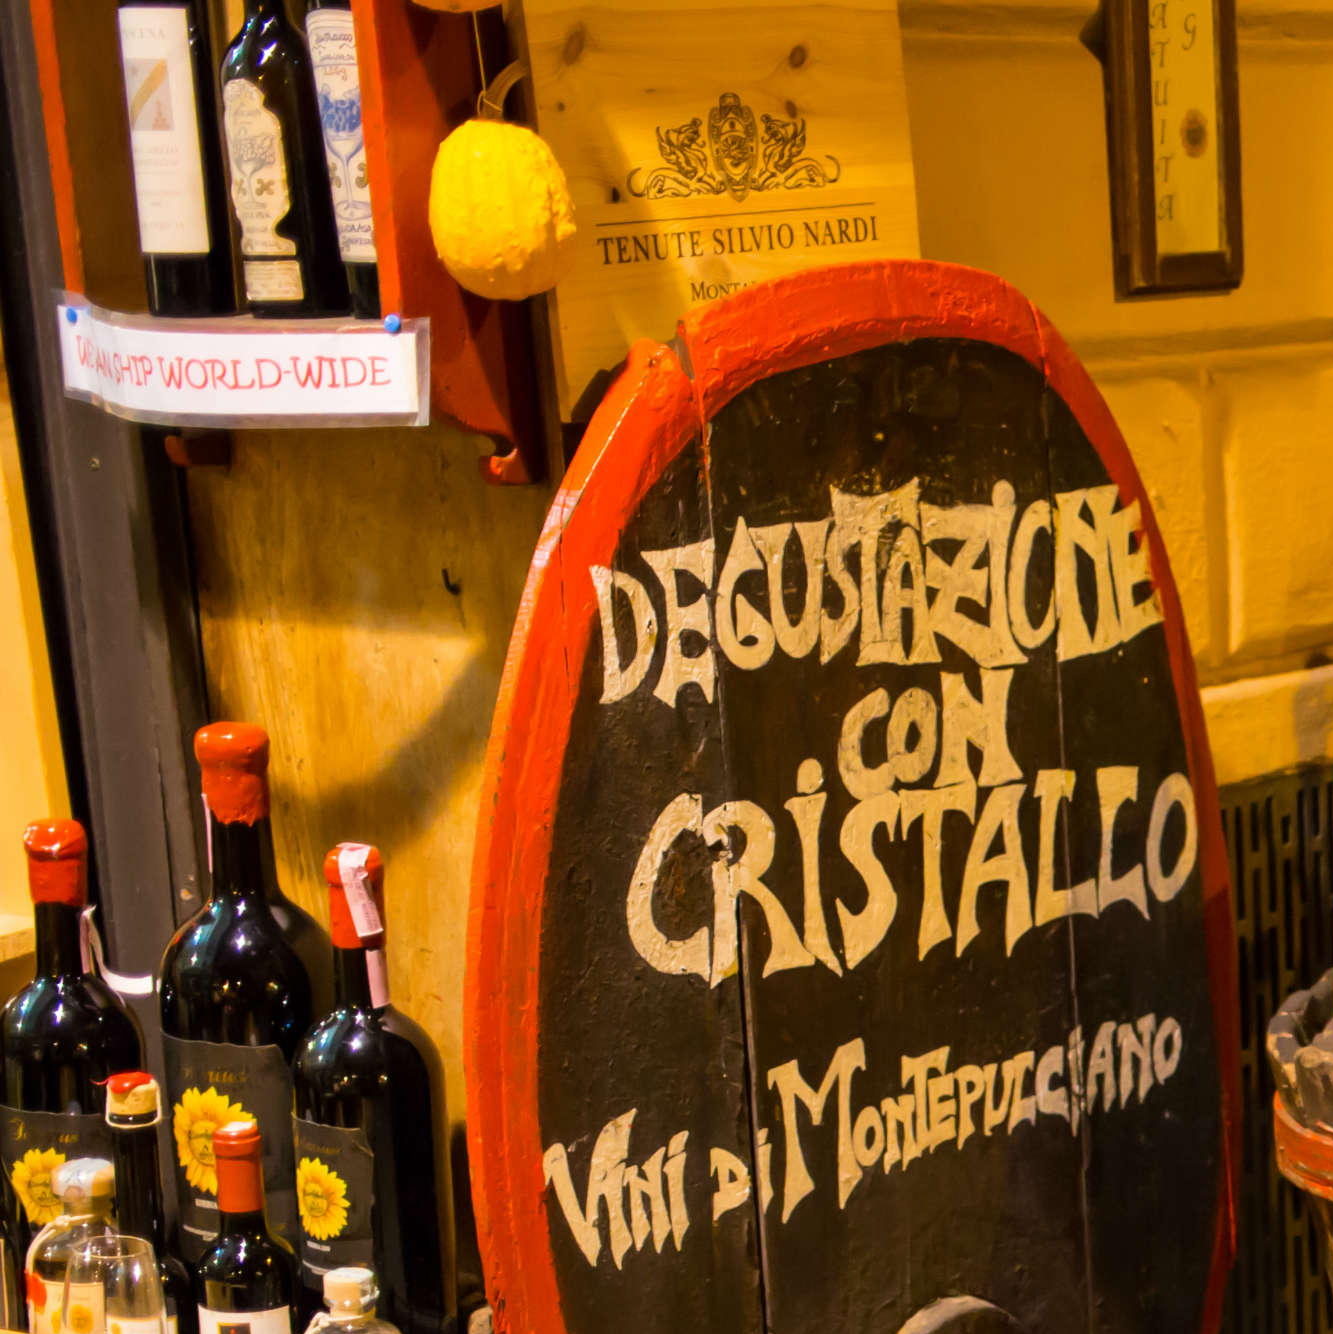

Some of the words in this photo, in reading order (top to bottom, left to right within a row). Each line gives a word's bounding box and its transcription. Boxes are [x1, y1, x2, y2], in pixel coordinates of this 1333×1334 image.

[596, 231, 704, 265] TENUTE
[712, 223, 795, 255] SILVIO
[803, 216, 880, 247] NARDI
[158, 355, 392, 391] WORLD-WIDE
[837, 669, 1022, 800] CON
